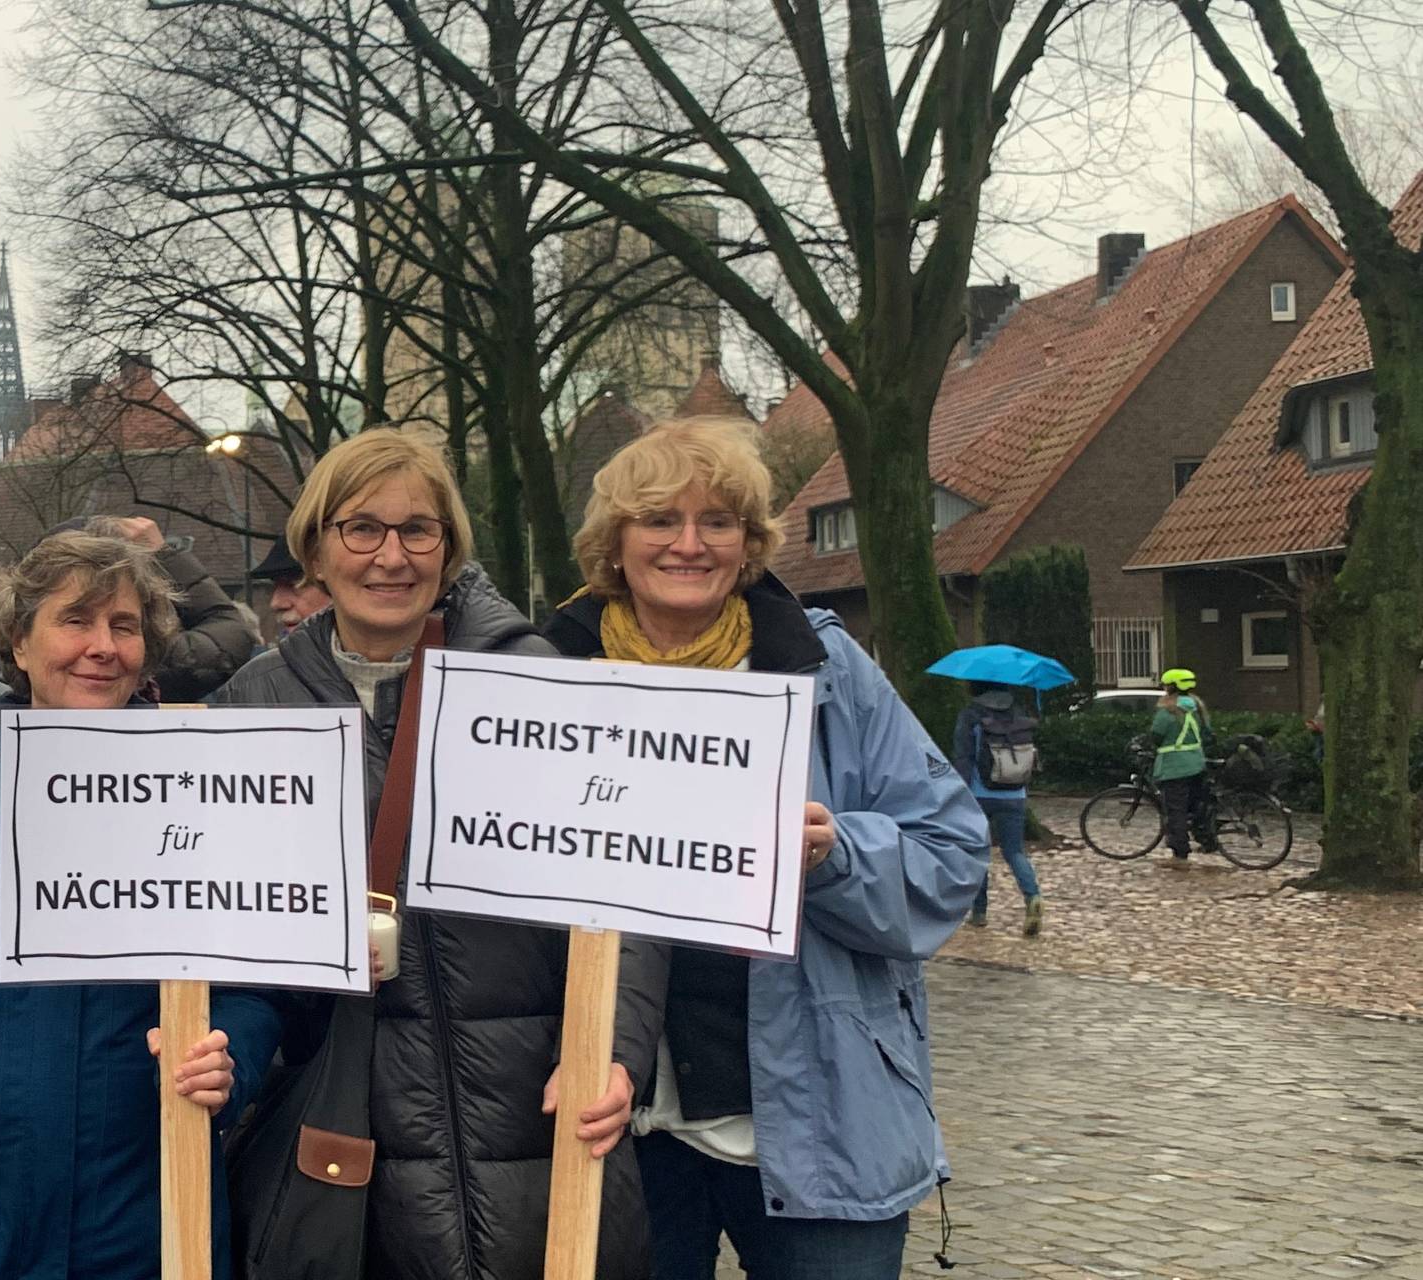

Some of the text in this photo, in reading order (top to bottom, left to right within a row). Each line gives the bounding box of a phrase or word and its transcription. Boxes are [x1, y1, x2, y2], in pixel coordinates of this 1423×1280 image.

[579, 775, 629, 806] für
[156, 824, 204, 857] für
[451, 811, 756, 878] NÄCHSTENLIEBE
[36, 871, 329, 915] NÄCHSTENLIEBE
